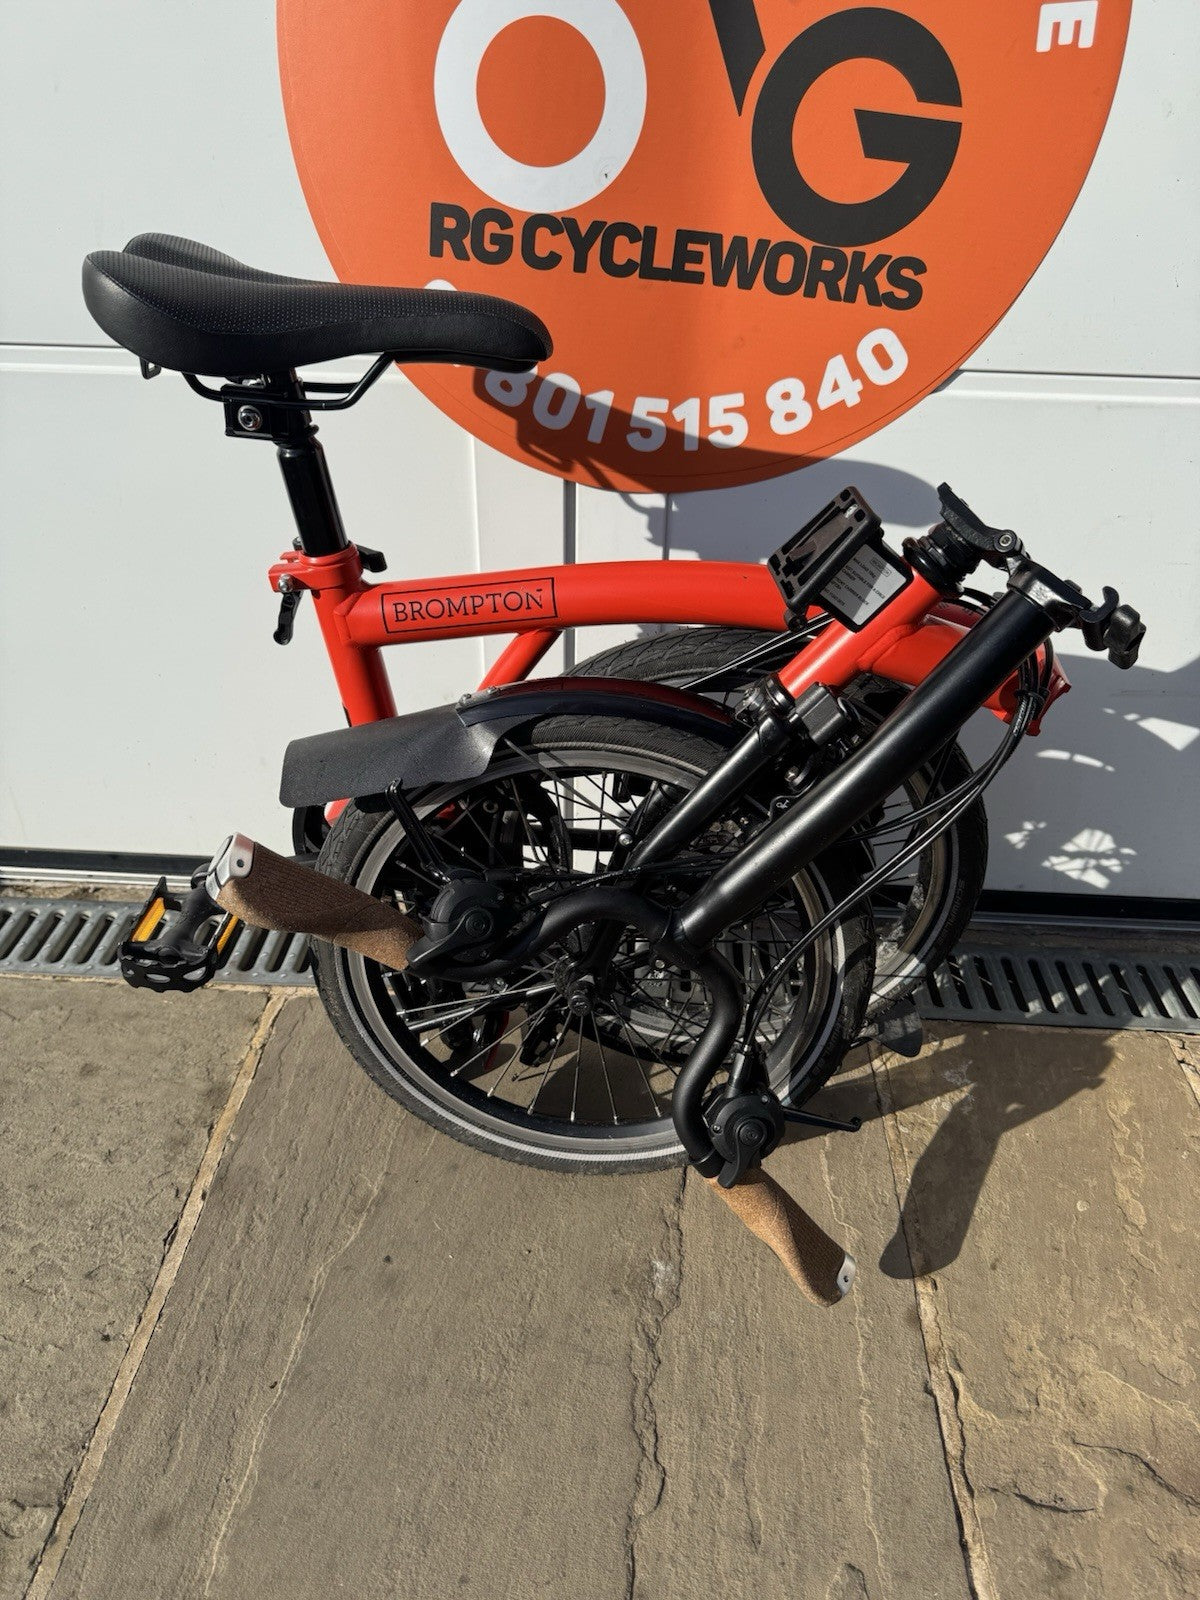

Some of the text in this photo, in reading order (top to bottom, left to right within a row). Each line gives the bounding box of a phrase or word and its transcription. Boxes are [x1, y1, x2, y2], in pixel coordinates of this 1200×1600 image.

[429, 202, 927, 311] RG CYCLEWORKS
[626, 392, 749, 452] 515
[765, 327, 909, 435] 840
[392, 588, 543, 623] BROMPTON
